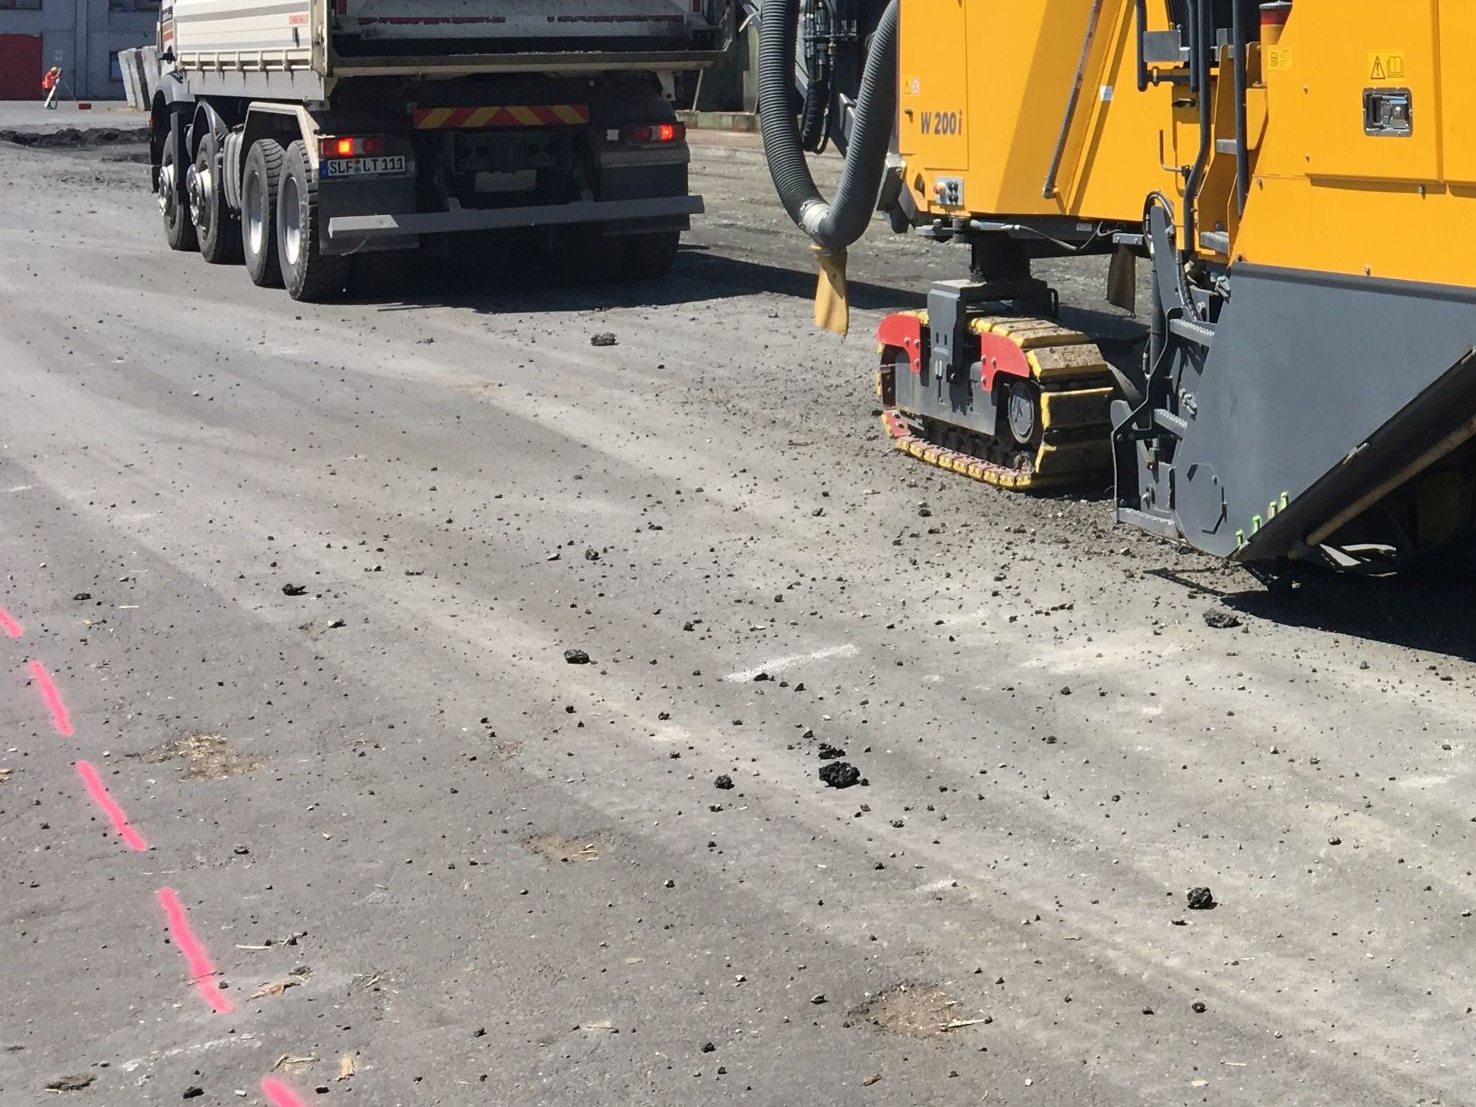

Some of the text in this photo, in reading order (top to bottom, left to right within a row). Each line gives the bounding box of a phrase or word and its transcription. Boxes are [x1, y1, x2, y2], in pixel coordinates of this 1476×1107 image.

[921, 111, 932, 135] W
[330, 157, 404, 174] SLF LT 111
